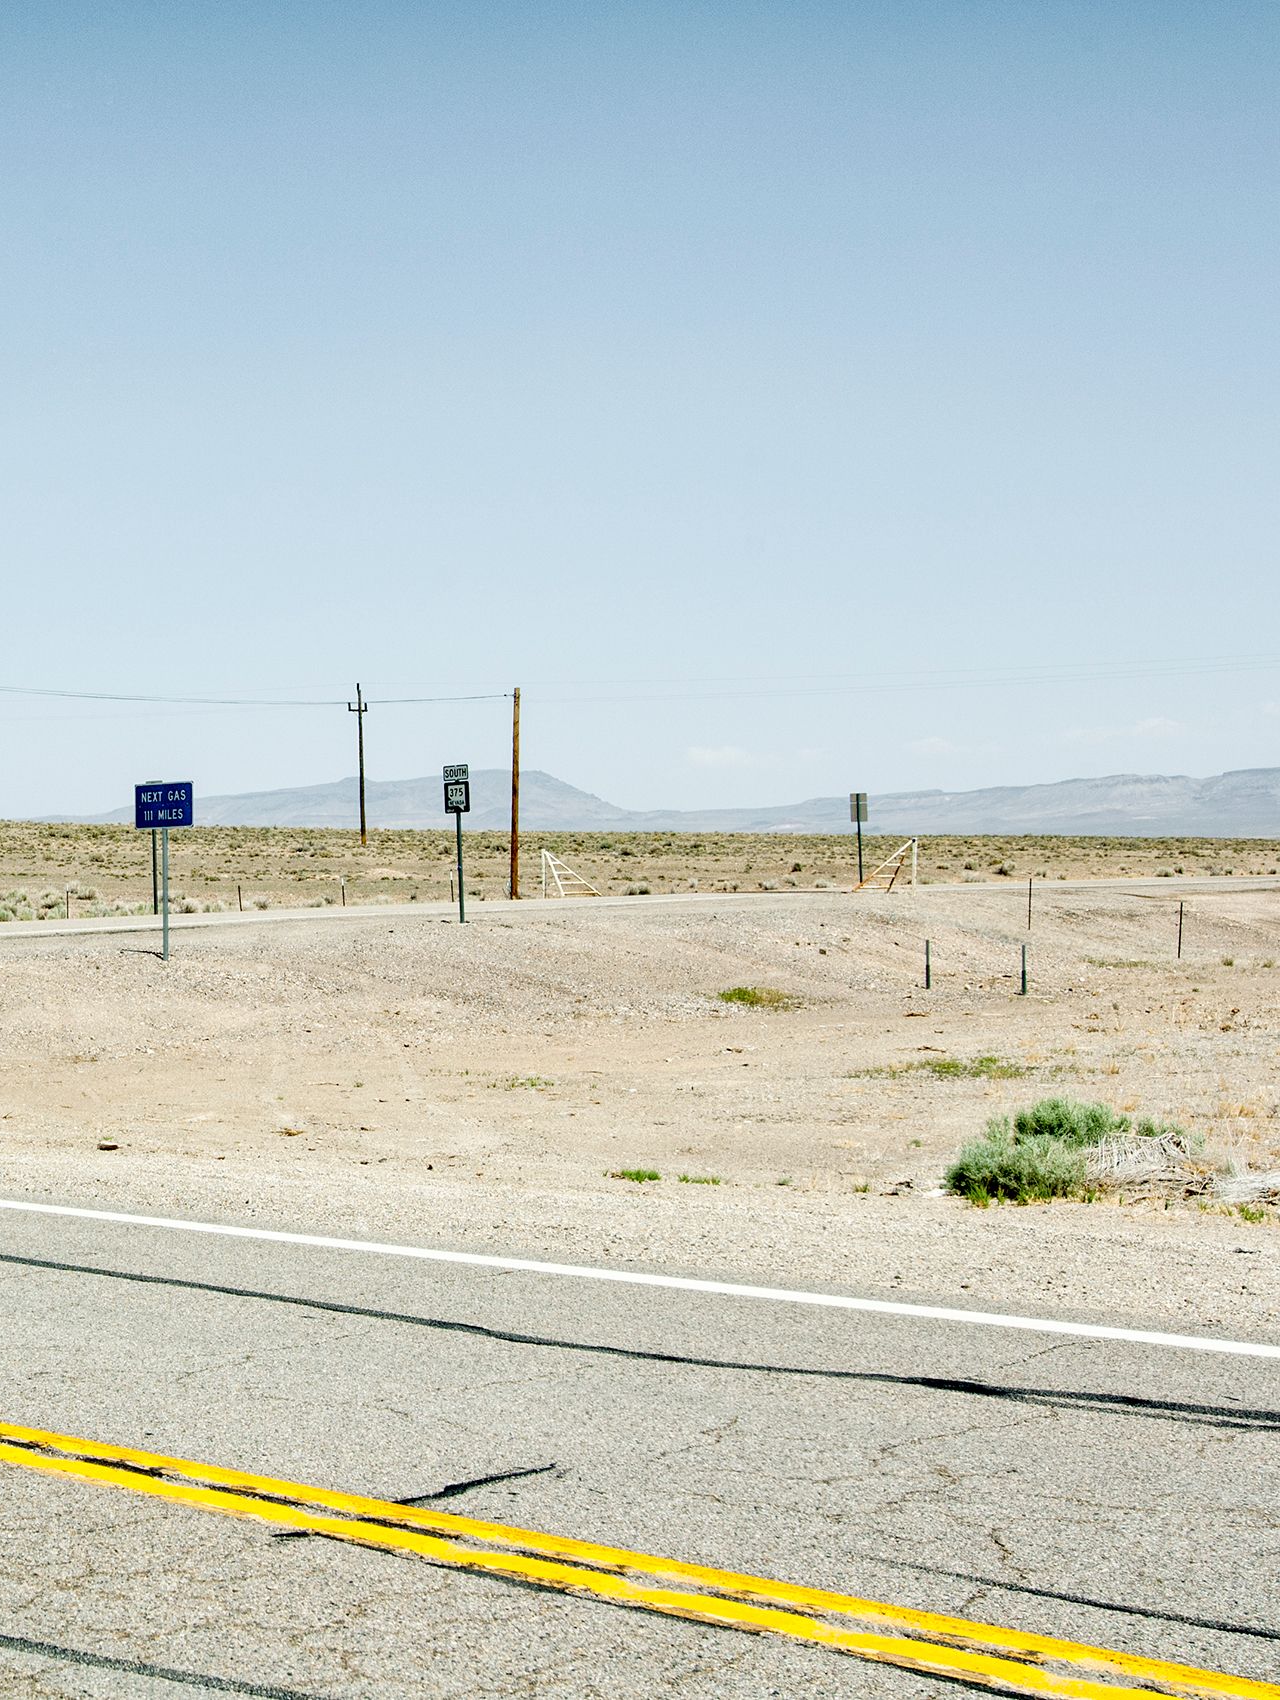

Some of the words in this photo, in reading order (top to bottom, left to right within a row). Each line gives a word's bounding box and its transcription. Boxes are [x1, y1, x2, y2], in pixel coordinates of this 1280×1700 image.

[445, 768, 466, 778] SOUTH
[141, 792, 162, 803] NEXT
[168, 790, 186, 801] GAS
[450, 788, 463, 797] 375
[158, 809, 183, 820] MILES
